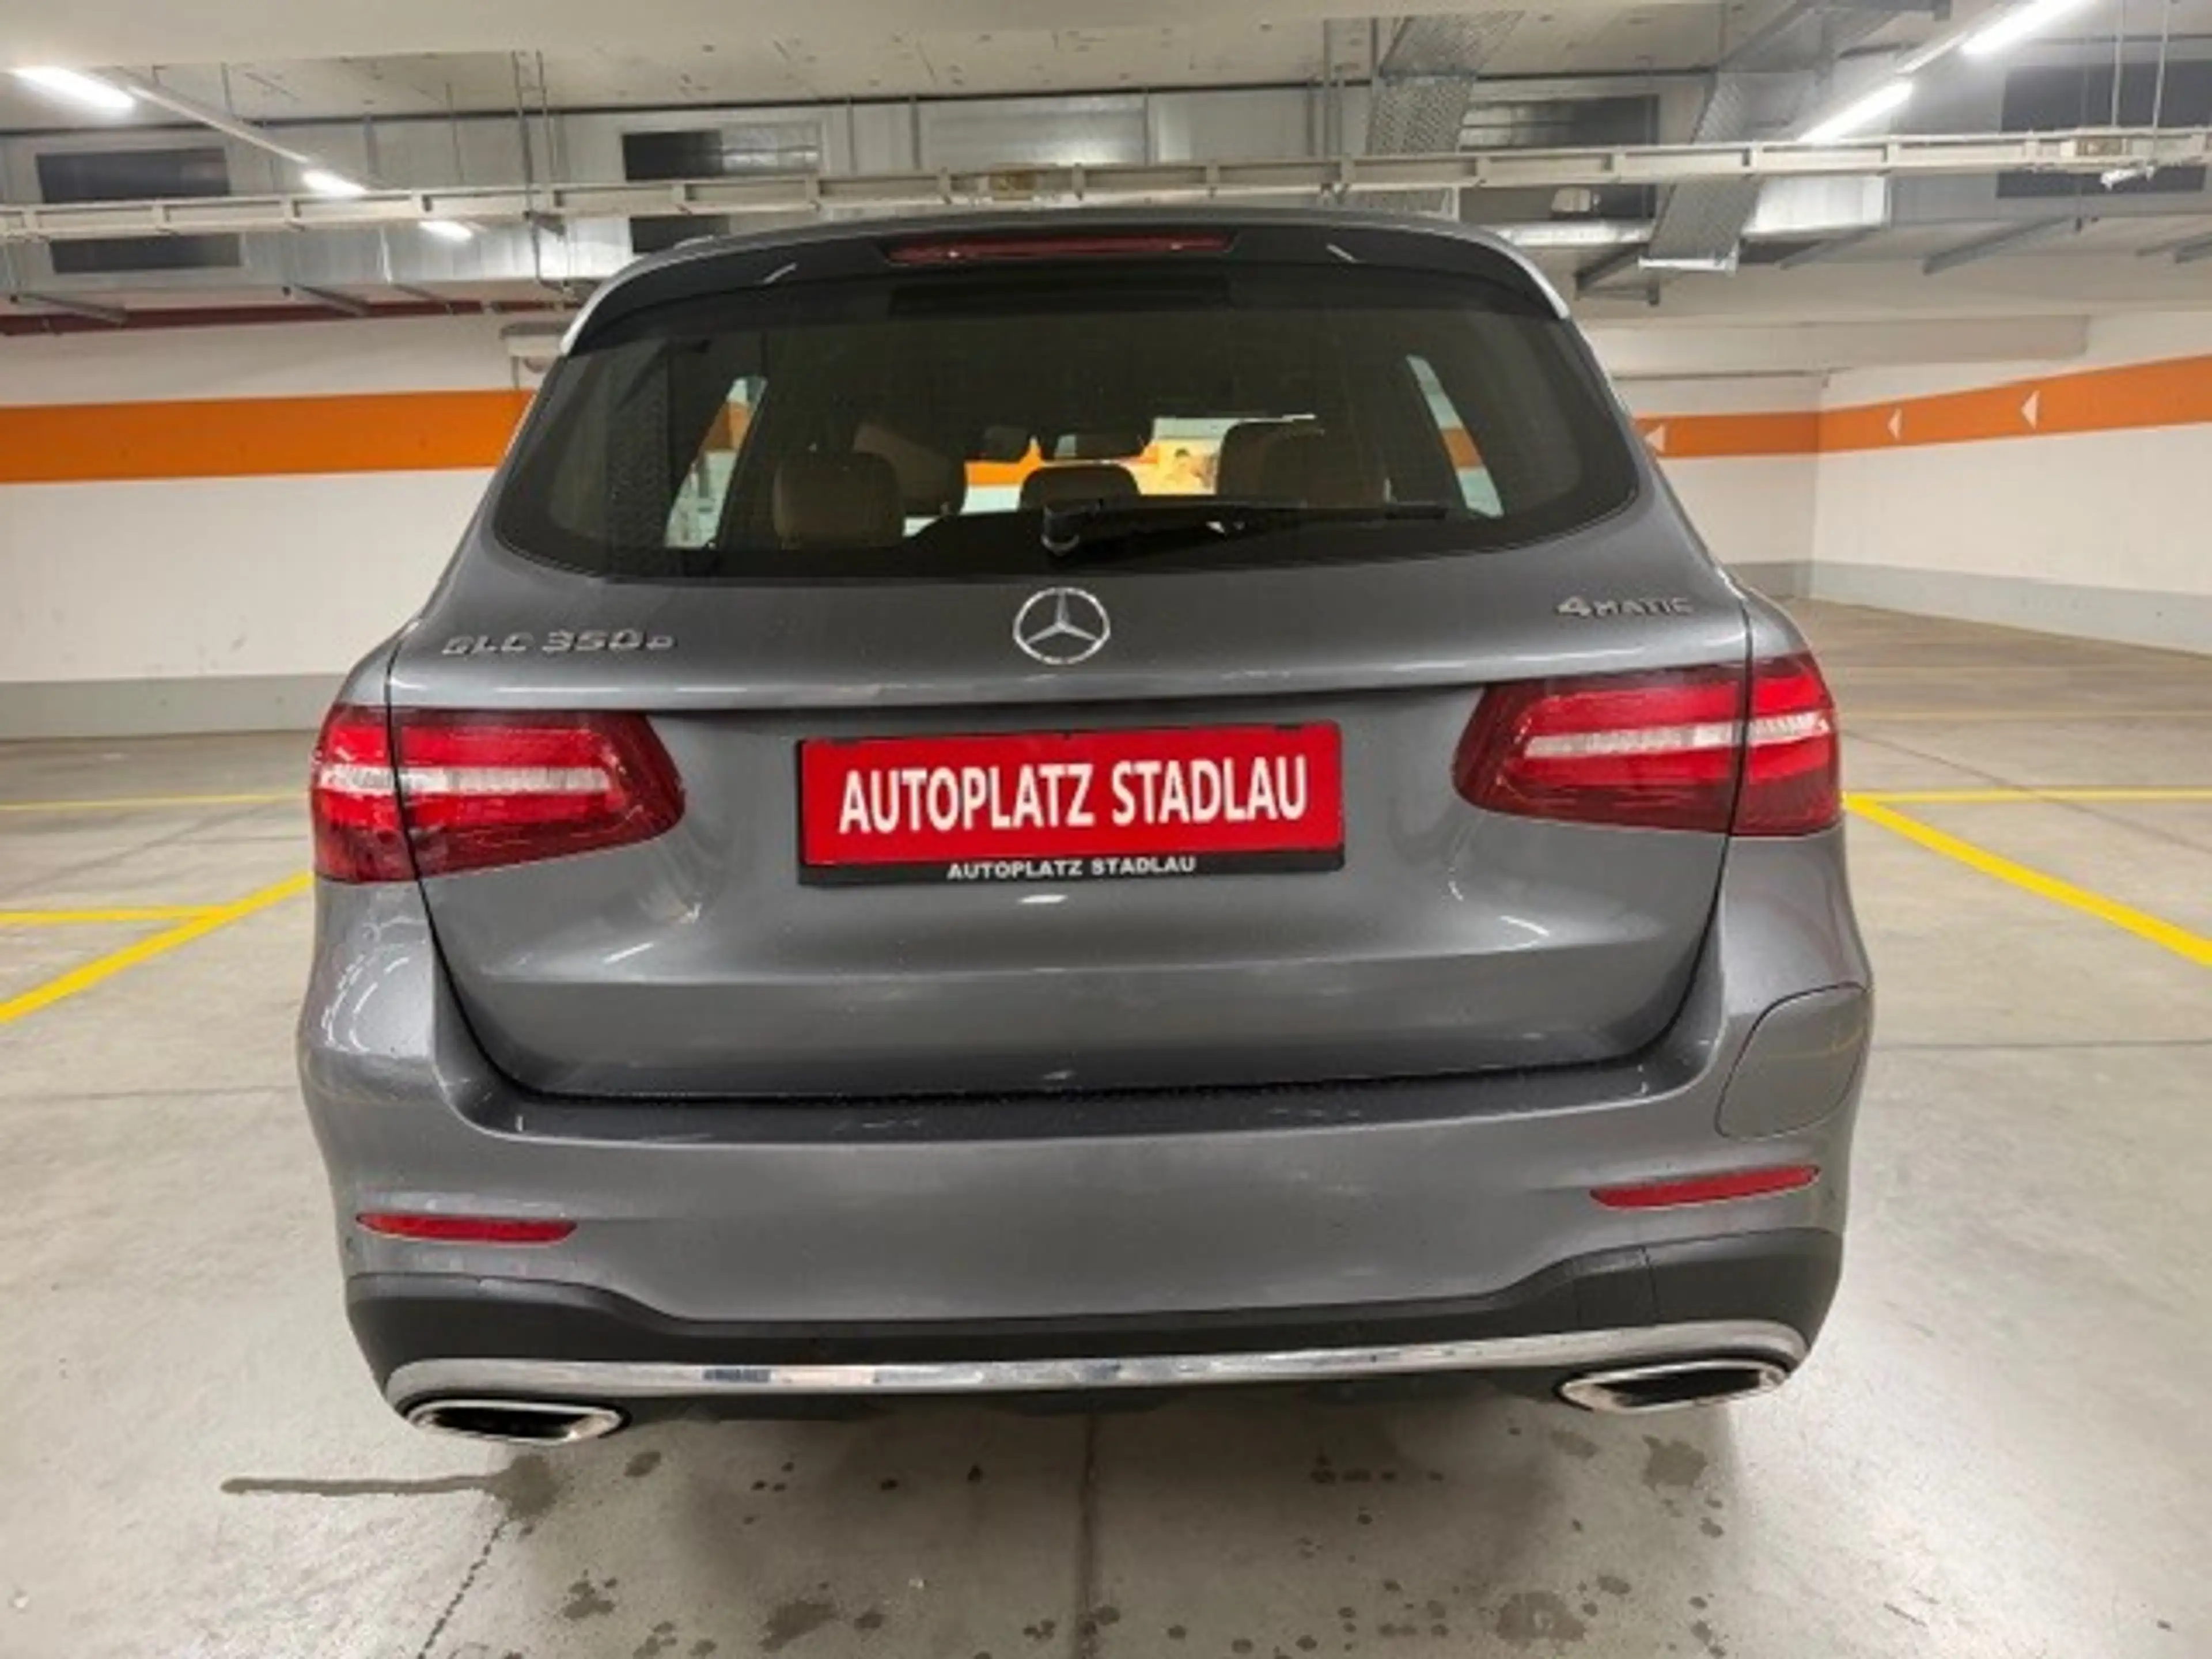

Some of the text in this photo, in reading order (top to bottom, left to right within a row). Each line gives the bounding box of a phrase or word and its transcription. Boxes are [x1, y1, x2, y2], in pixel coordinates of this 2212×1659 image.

[1556, 596, 1692, 616] 4MATIC
[441, 633, 534, 656] GLC
[839, 755, 1306, 834] AUTOPLATZ STADLAU
[947, 856, 1196, 880] AUTOPLATZ STADLAU
